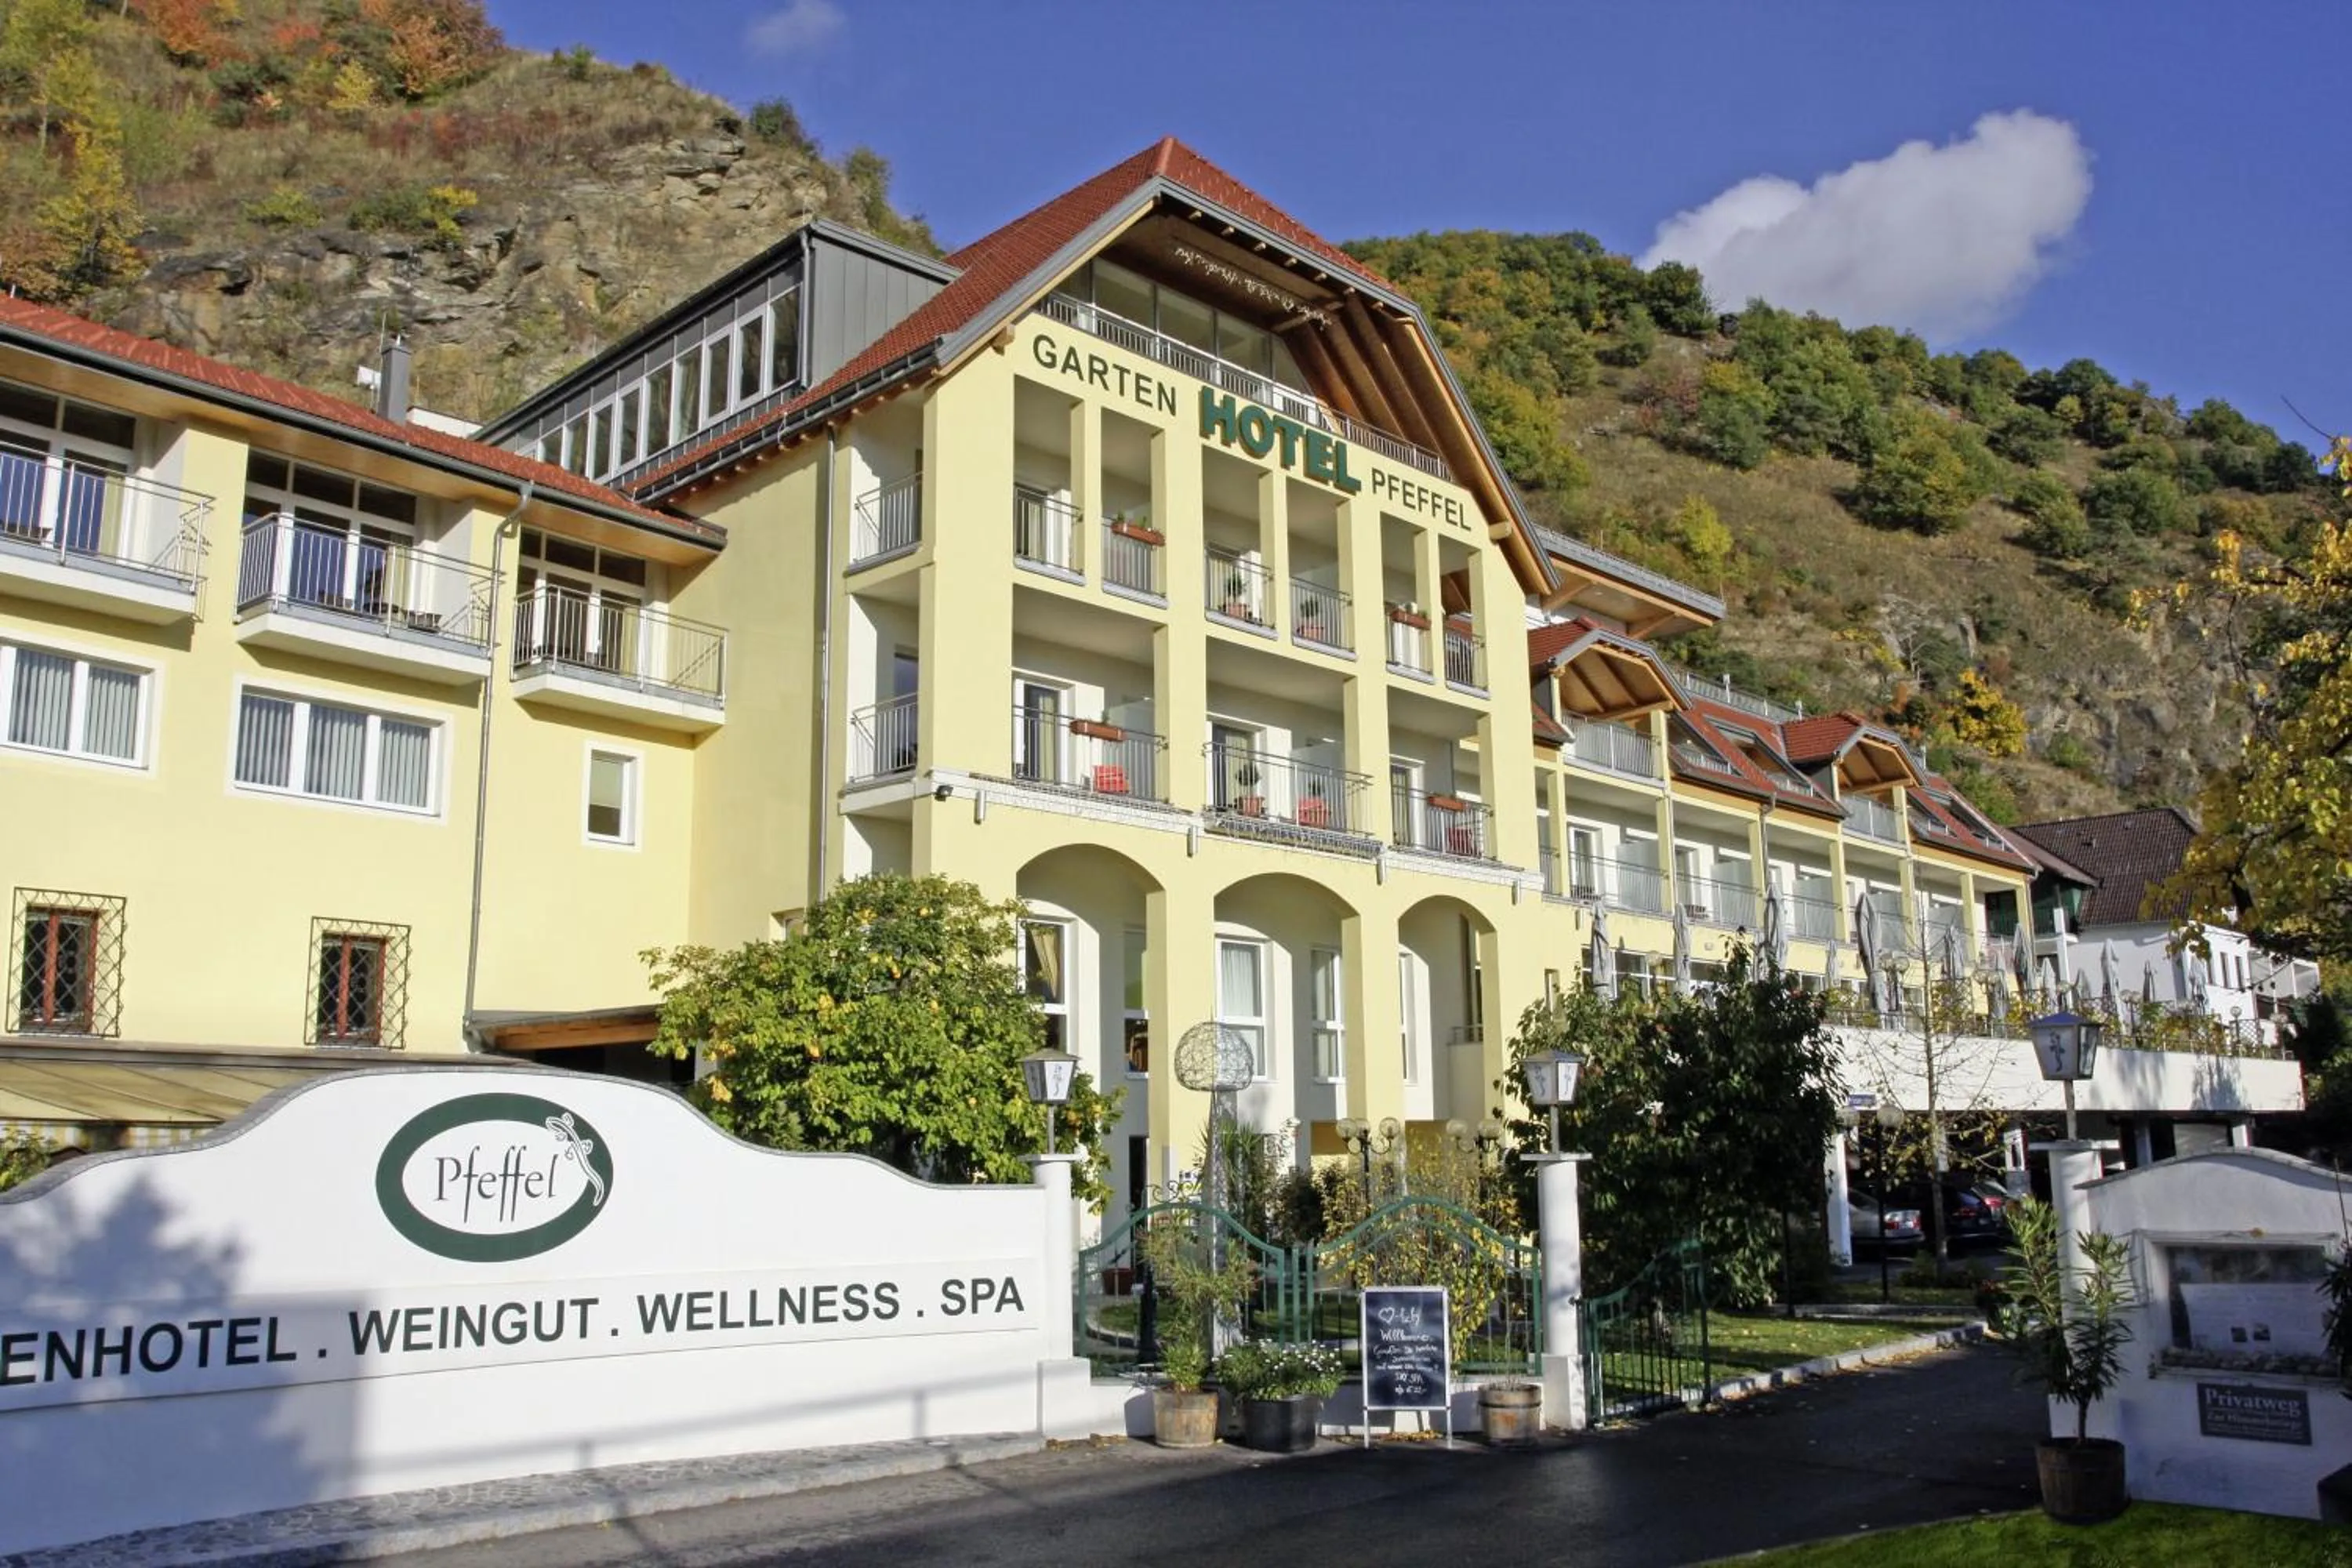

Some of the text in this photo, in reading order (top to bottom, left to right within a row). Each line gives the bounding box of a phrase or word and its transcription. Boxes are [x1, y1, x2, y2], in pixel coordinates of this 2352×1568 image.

[1033, 333, 1472, 532] GARTEN HOTEL PFEFFEL
[434, 1145, 558, 1223] Pfeffel
[348, 1297, 601, 1356] WEINGUT
[637, 1281, 900, 1334] WELLNESS
[940, 1276, 1025, 1316] SPA
[2205, 1388, 2302, 1418] Privatweg
